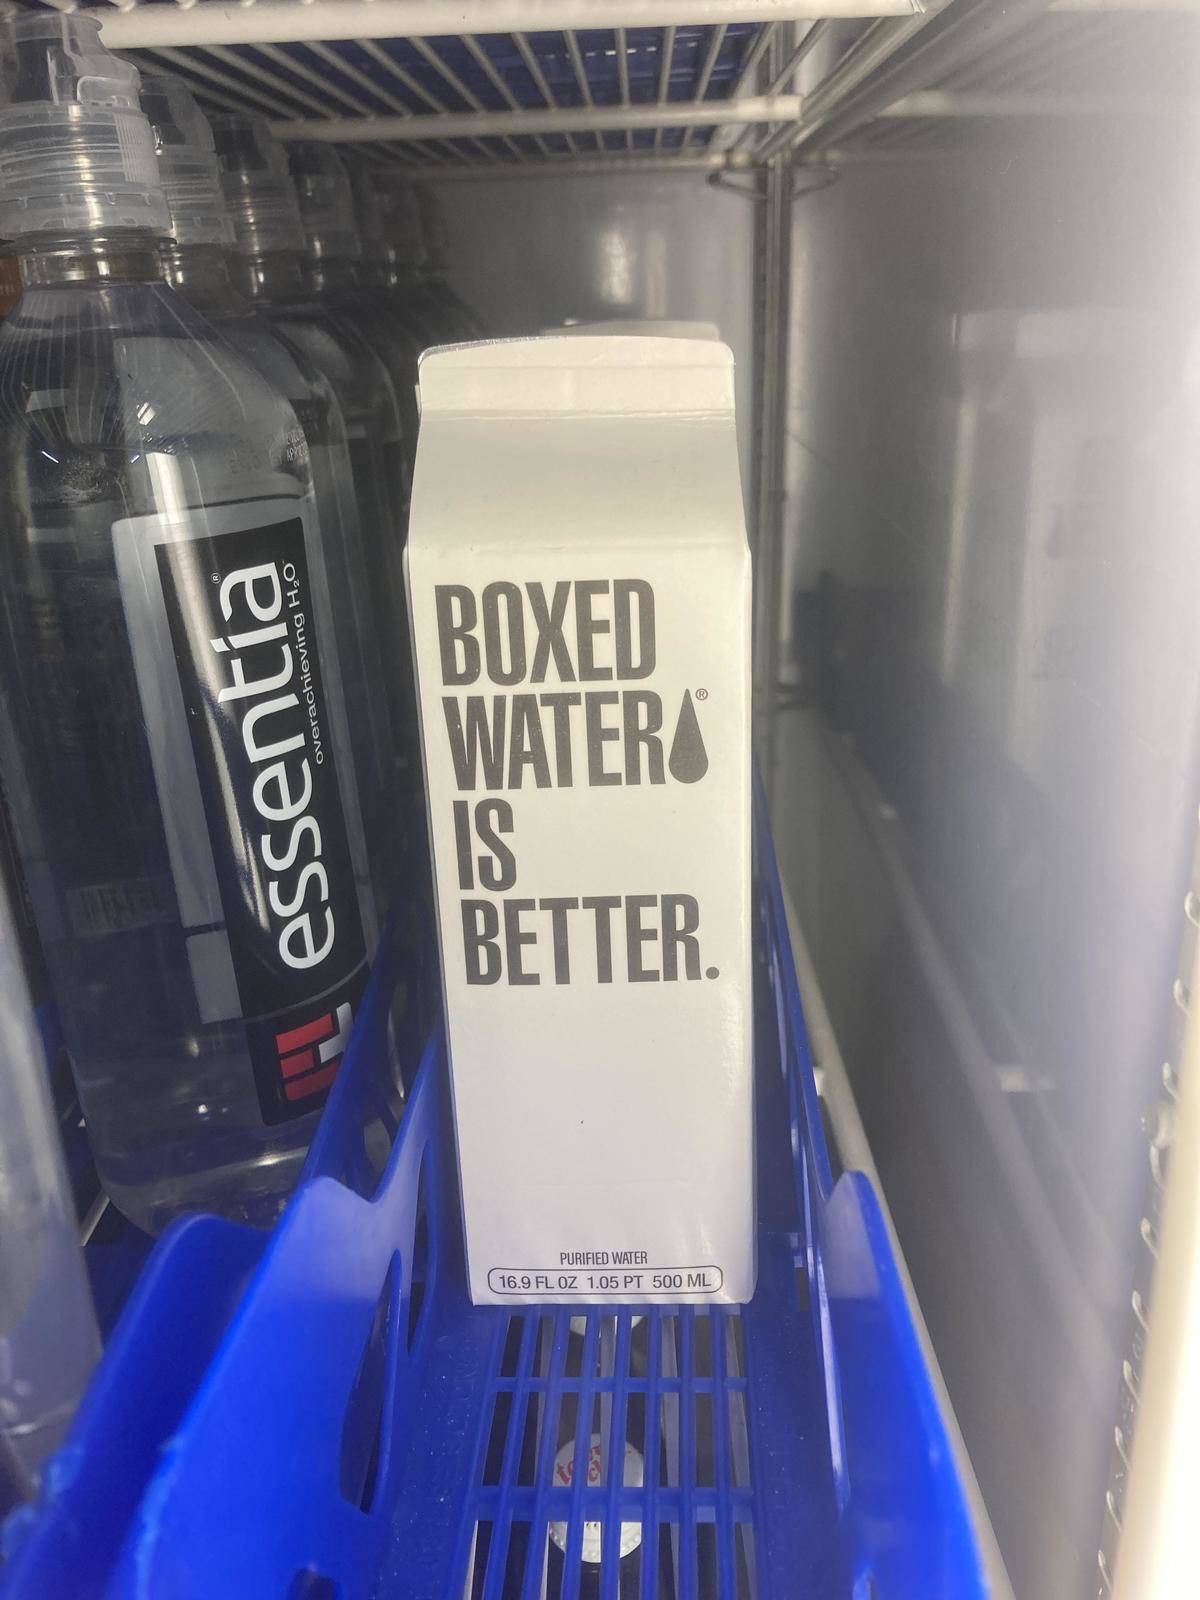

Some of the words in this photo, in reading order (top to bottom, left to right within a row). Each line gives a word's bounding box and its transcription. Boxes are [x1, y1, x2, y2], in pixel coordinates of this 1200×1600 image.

[434, 579, 657, 687] BOXED
[293, 613, 324, 765] overachieving
[209, 562, 336, 970] essentia
[441, 690, 667, 791] WATER
[452, 797, 517, 892] IS
[460, 893, 720, 986] BETTER.
[498, 1274, 531, 1289] 16.9
[535, 1275, 554, 1289] FL
[587, 1275, 619, 1289] 1.05
[623, 1274, 643, 1289] PT
[652, 1273, 683, 1288] 500
[687, 1272, 712, 1288] ML
[560, 1251, 609, 1266] PURIFIED
[612, 1250, 648, 1265] WATER
